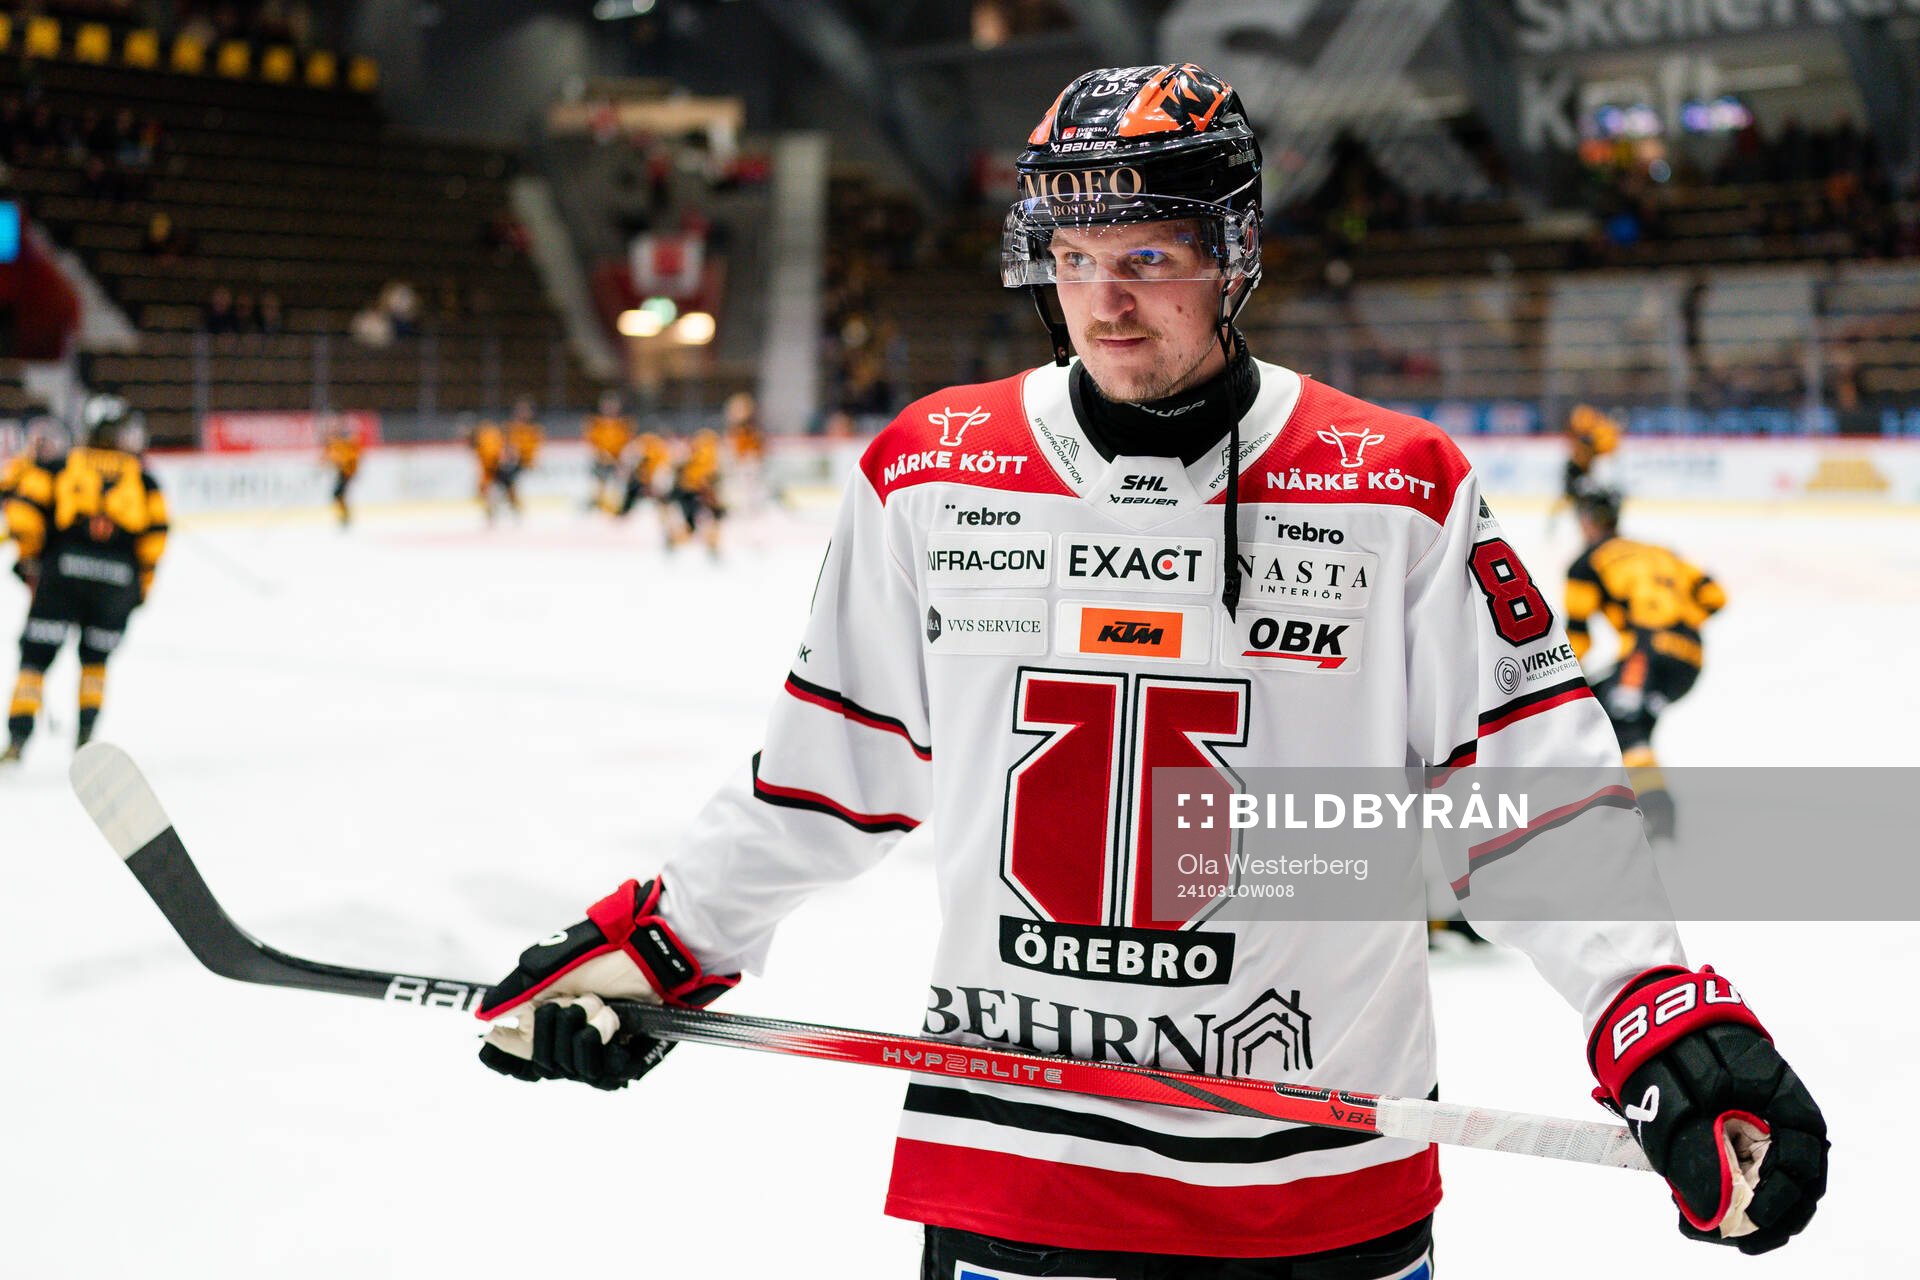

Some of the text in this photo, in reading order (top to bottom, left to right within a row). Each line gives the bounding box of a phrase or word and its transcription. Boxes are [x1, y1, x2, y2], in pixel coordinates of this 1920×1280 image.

[1023, 166, 1142, 204] MOFO
[884, 451, 1028, 485] NÄRKE KÖTT
[1034, 417, 1084, 485] BYGGPRODUKTION
[1208, 431, 1272, 489] BYGGODUKTION
[1121, 474, 1169, 492] SHL
[1266, 468, 1436, 500] NÄRKE KÖTT
[1237, 554, 1368, 588] NASTA
[1260, 584, 1343, 600] INTERIÖR
[1468, 537, 1554, 647] 8
[948, 619, 1041, 633] VVS SERVICE
[1097, 621, 1165, 645] KTM
[1249, 617, 1350, 656] OBK
[1014, 923, 1219, 980] ÖREBRO
[921, 984, 1217, 1074] BEHRN
